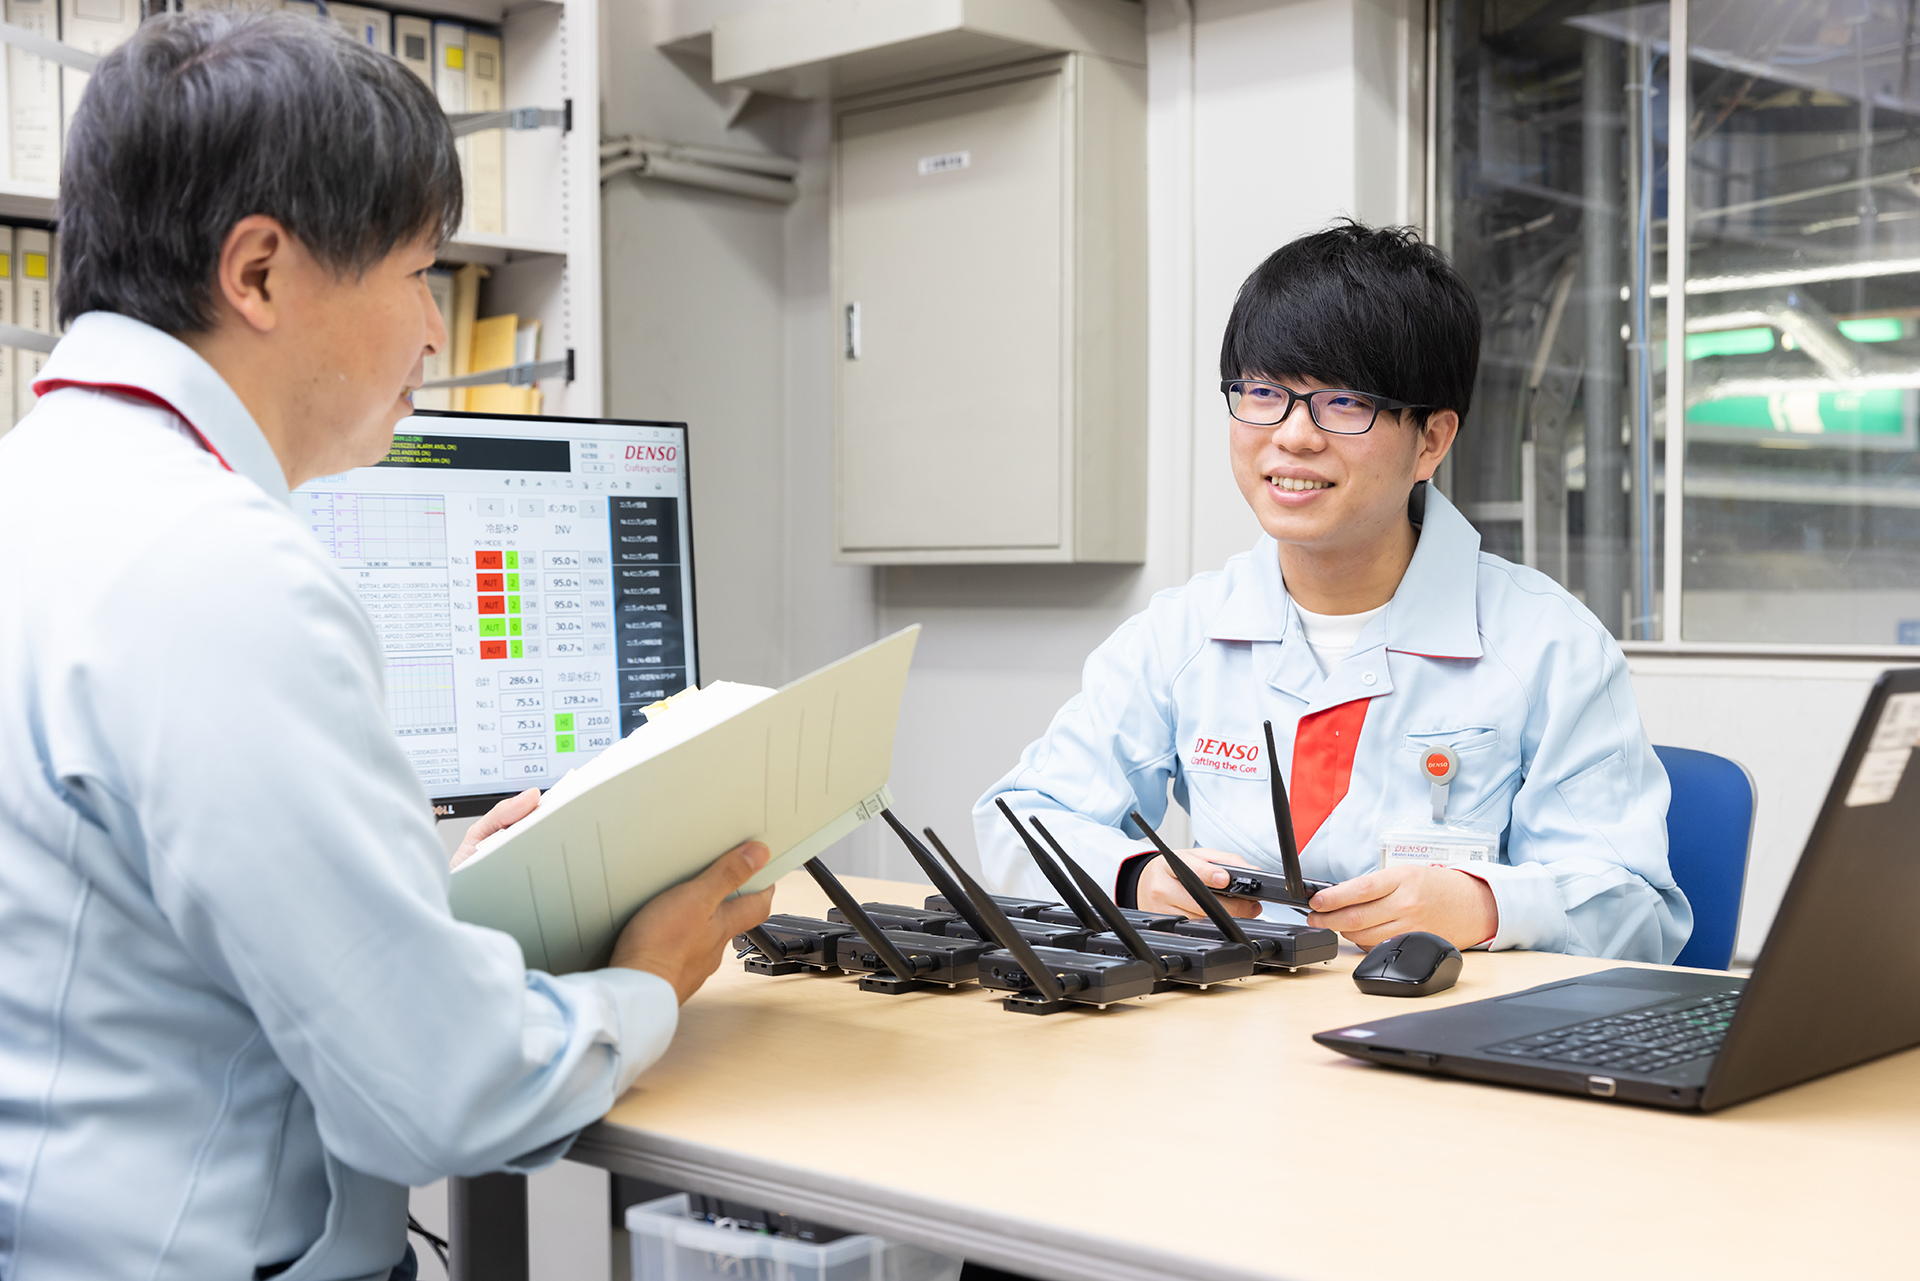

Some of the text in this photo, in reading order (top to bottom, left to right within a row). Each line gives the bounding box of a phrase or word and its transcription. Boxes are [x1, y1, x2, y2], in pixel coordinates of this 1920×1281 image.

[624, 445, 676, 462] DENSO
[624, 464, 676, 474] Crafting the Core
[555, 524, 572, 534] INV
[452, 557, 469, 565] No.1
[452, 579, 470, 588] No.2
[483, 579, 498, 587] AUT
[554, 578, 572, 586] 95.0
[454, 602, 472, 610] No.3
[484, 602, 498, 610] AUT
[554, 600, 572, 608] 95.0
[455, 624, 473, 632] No.4
[485, 624, 500, 632] AUT
[556, 622, 574, 630] 30.0
[456, 646, 474, 655] No.5
[486, 646, 501, 654] AUT
[514, 646, 519, 654] 2
[557, 644, 574, 652] 49.7
[509, 678, 533, 686] 286.9
[476, 700, 494, 709] No.1
[516, 698, 534, 706] 75.5
[564, 696, 586, 704] 178.2
[517, 720, 536, 729] 75.3
[587, 716, 610, 726] 210.0
[478, 722, 496, 731] No.2
[518, 742, 536, 751] 75.7
[588, 738, 611, 747] 140.0
[479, 745, 497, 754] No.3
[1195, 738, 1258, 761] DENSO
[480, 767, 498, 776] No.4
[524, 764, 538, 774] 0.0
[1222, 761, 1238, 772] the
[1240, 764, 1258, 774] Core
[1394, 845, 1428, 854] DENSO
